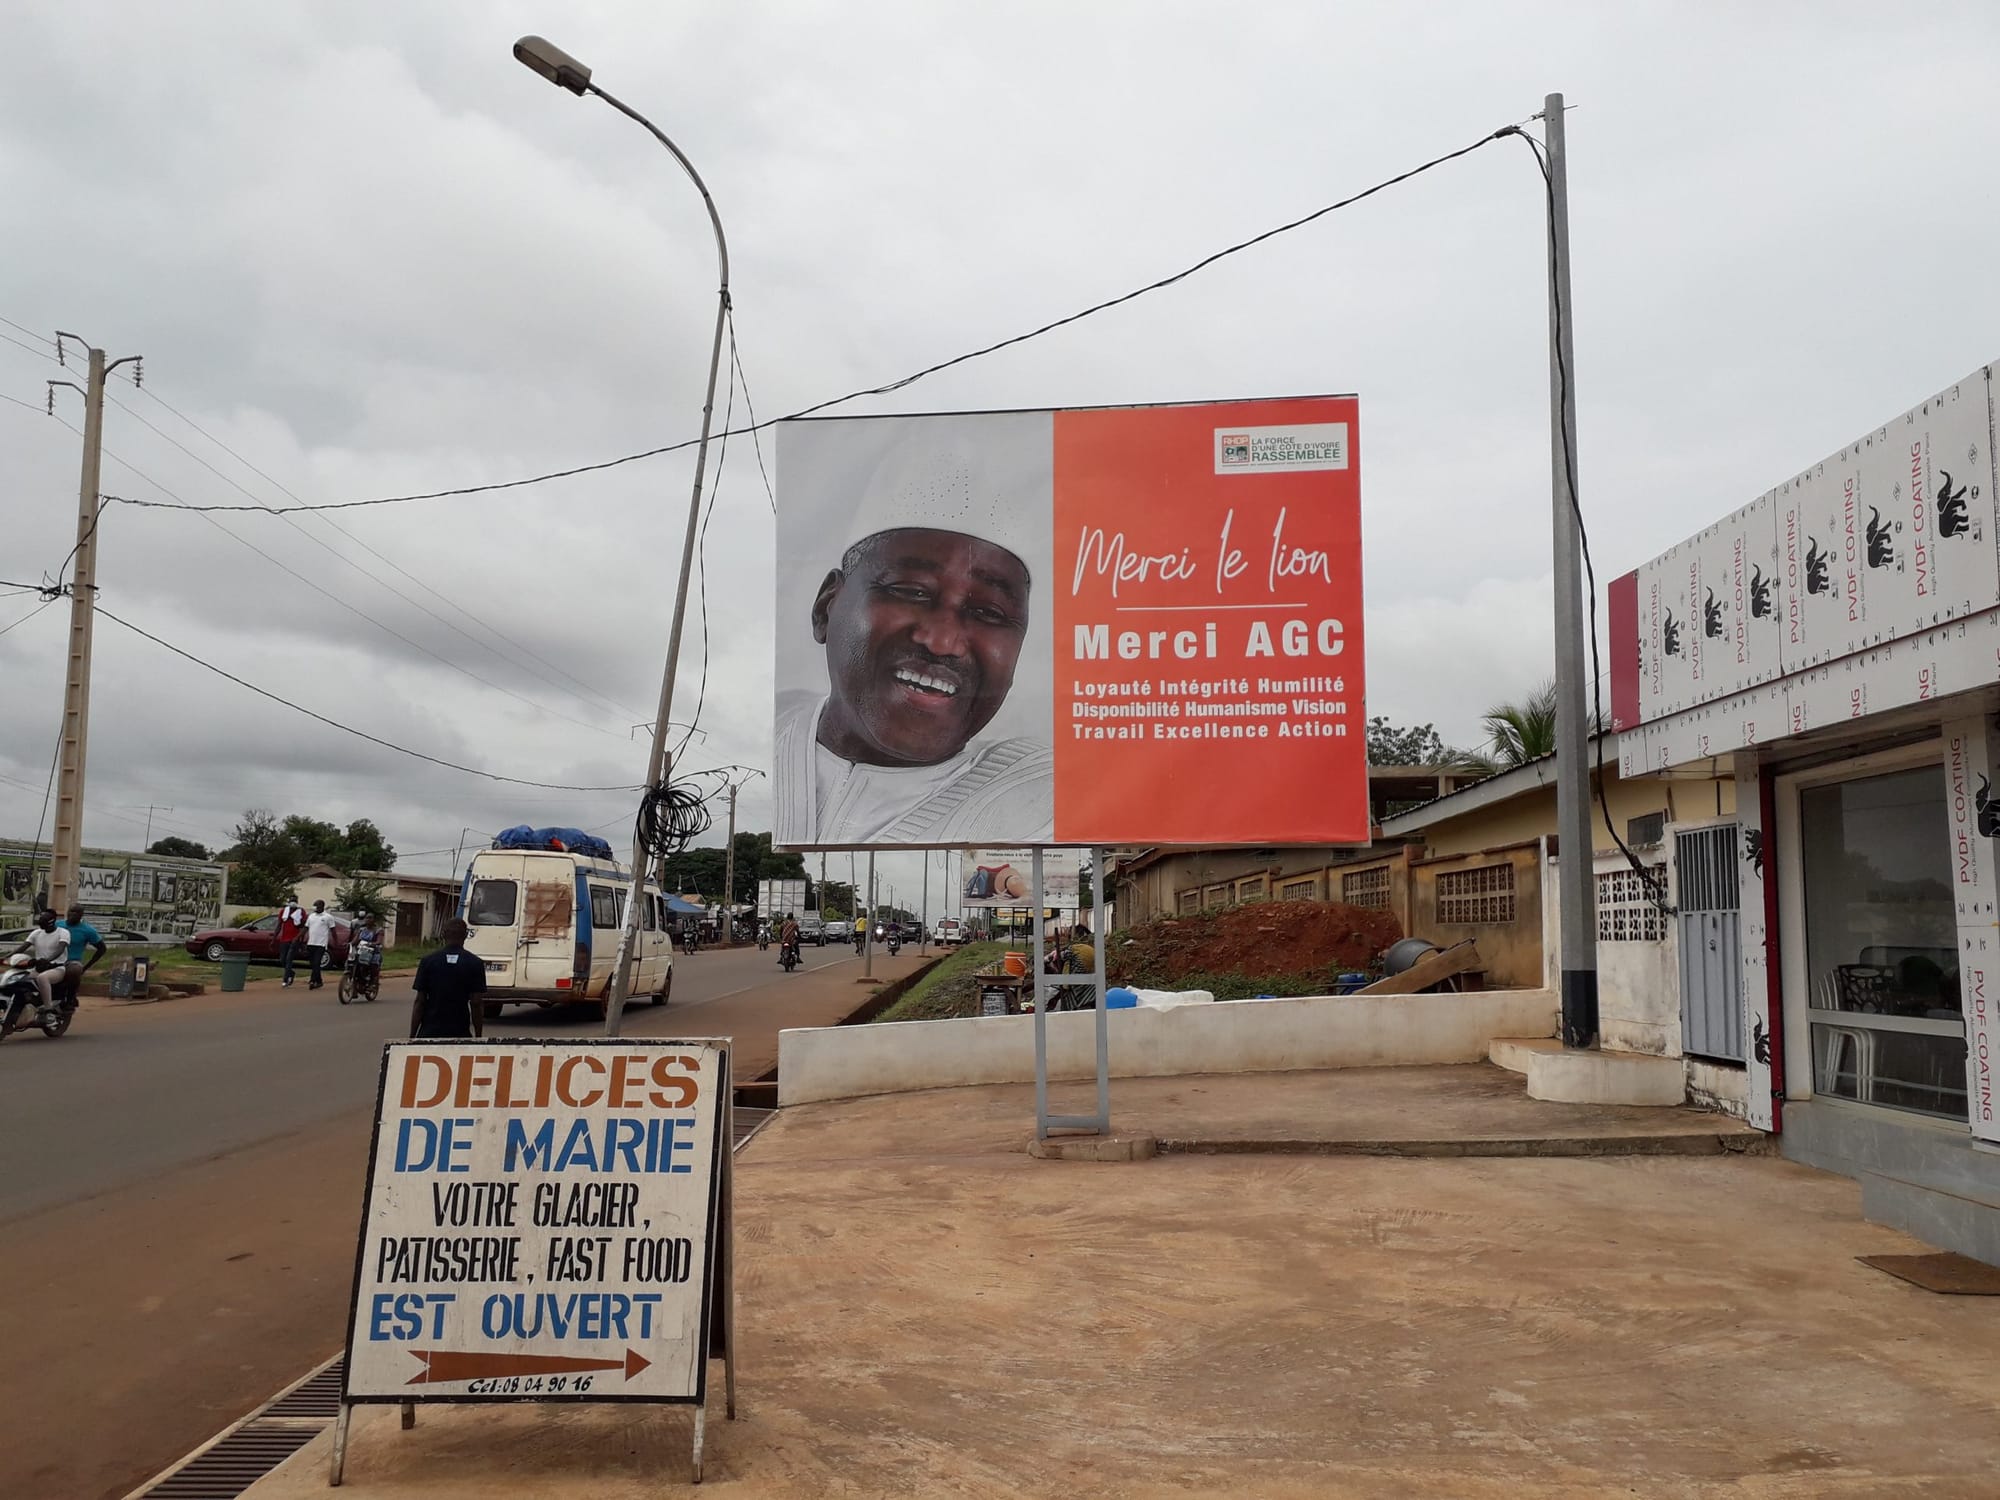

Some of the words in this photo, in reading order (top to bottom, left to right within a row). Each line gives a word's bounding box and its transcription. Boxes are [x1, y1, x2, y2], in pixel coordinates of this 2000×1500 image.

[1252, 448, 1341, 462] RASSEMBLÉE
[1265, 436, 1296, 444] FORCE
[1304, 441, 1340, 450] D'IVOIRE
[1911, 441, 1924, 532] COATING
[1844, 478, 1856, 562] COATING
[1072, 525, 1196, 598] Merci
[1216, 508, 1248, 594] le
[1269, 506, 1331, 593] lion
[1734, 537, 1743, 612] COATING
[1787, 509, 1797, 588] COATING
[1915, 538, 1928, 596] PVDF
[1690, 562, 1698, 631] COATING
[1789, 595, 1799, 643] PVDF
[1847, 568, 1858, 621] PVDF
[1074, 623, 1217, 660] Merci
[1245, 618, 1344, 657] AGC
[1736, 616, 1745, 663] PVDF
[1073, 702, 1180, 720] Disponibilité
[1186, 700, 1287, 717] Humanisme
[1292, 699, 1346, 715] Vision
[1074, 680, 1151, 698] Loyauté
[1160, 678, 1249, 697] Intégrité
[1258, 676, 1344, 694] Humilité
[1073, 723, 1144, 739] Travail
[1154, 722, 1269, 739] Excellence
[1278, 721, 1346, 737] Action
[1951, 738, 1966, 823] COATING
[1957, 829, 1971, 883] PVDF
[1974, 970, 1986, 1027] PVDF
[400, 1055, 701, 1109] DELICES
[1977, 1032, 1992, 1121] COATING
[394, 1118, 474, 1173] DE
[503, 1118, 696, 1173] MARIE
[433, 1182, 520, 1227] VOTRE
[546, 1237, 613, 1282] FAST
[622, 1237, 692, 1283] FOOD
[369, 1293, 457, 1341] EST
[481, 1293, 662, 1340] OUVERT
[525, 1377, 543, 1392] 04
[548, 1376, 567, 1392] 90
[571, 1376, 594, 1391] 16
